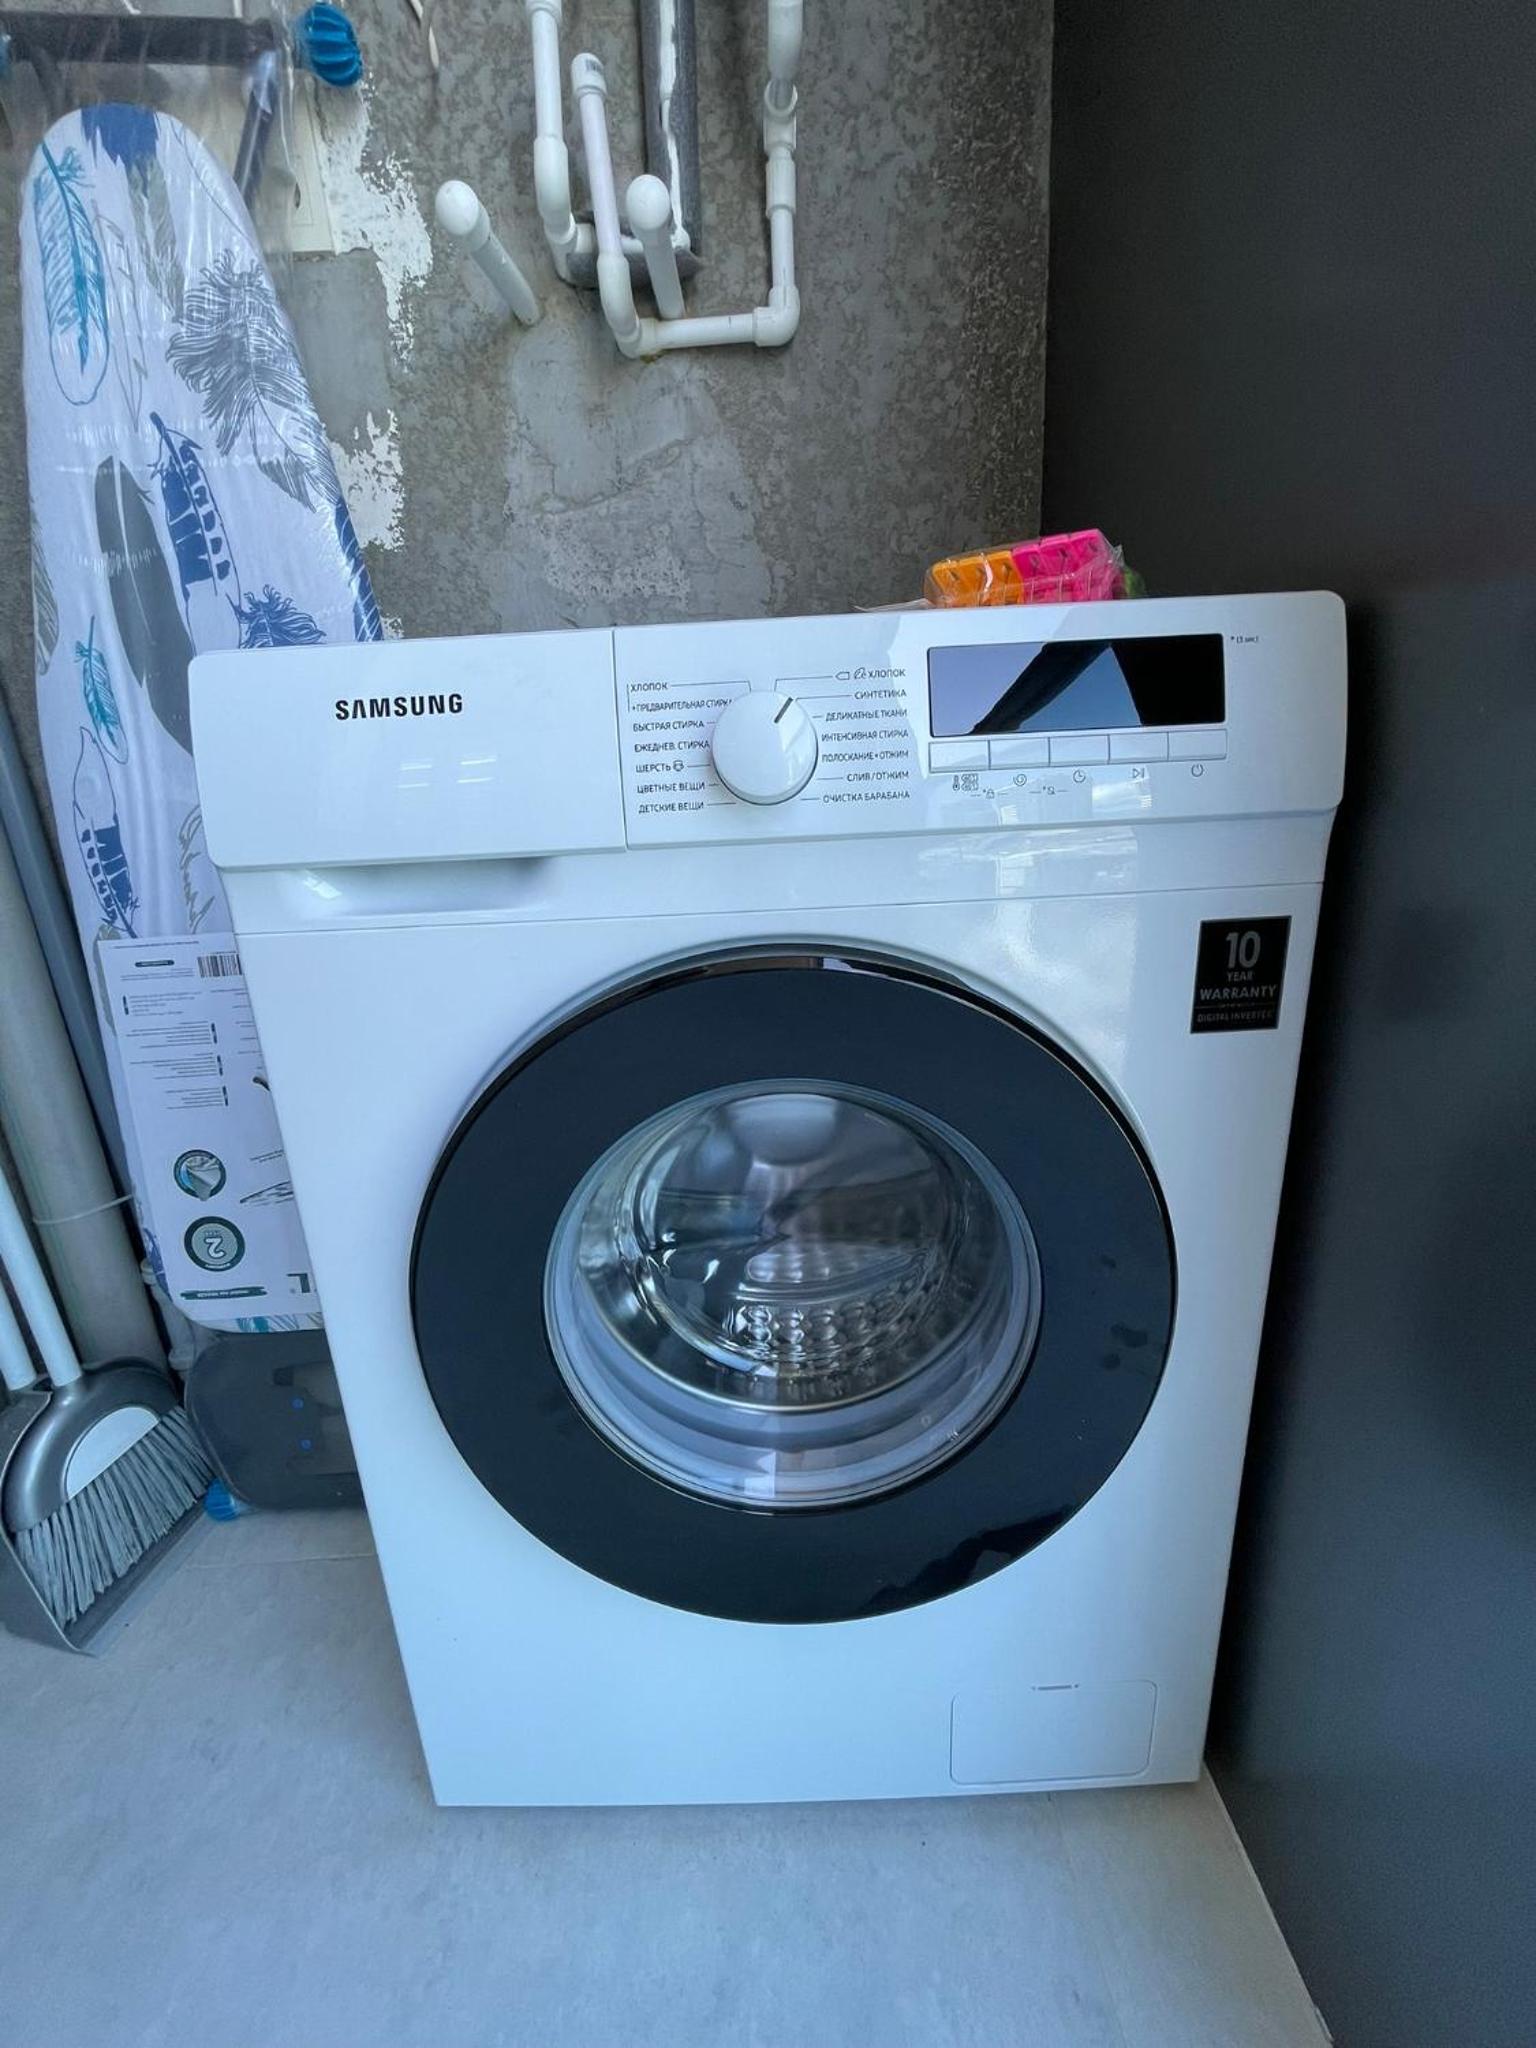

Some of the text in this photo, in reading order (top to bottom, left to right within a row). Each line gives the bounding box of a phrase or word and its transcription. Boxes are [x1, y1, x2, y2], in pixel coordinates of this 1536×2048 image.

[868, 668, 906, 678] ХЛОПОК
[630, 682, 668, 692] ХЛОПОК
[854, 689, 907, 700] СИНТЕТИКА
[335, 693, 463, 721] SAMSUNG
[706, 699, 732, 708] СТИРК
[826, 708, 908, 722] ДЕЛИКАТНЫЕ ТКАНИ
[633, 720, 704, 732] БЫСТРАЯ СТИРКА
[822, 729, 908, 742] ИНТЕНСИВНАЯ СТИРКА
[678, 740, 710, 750] СТИРКА
[636, 762, 671, 773] ШЕРСТЬ
[637, 782, 705, 794] ЦВЕТНЫЕ ВЕЩИ
[823, 790, 911, 804] ОЧИСТКА БАРАБАНА
[638, 802, 704, 814] ДЕТСКИЕ ВЕЩИ
[1226, 930, 1261, 969] 10
[1226, 970, 1254, 982] YEAR
[1199, 984, 1278, 1000] WARRANTY
[1197, 1012, 1229, 1023] DIGITAL
[203, 1236, 226, 1259] 2
